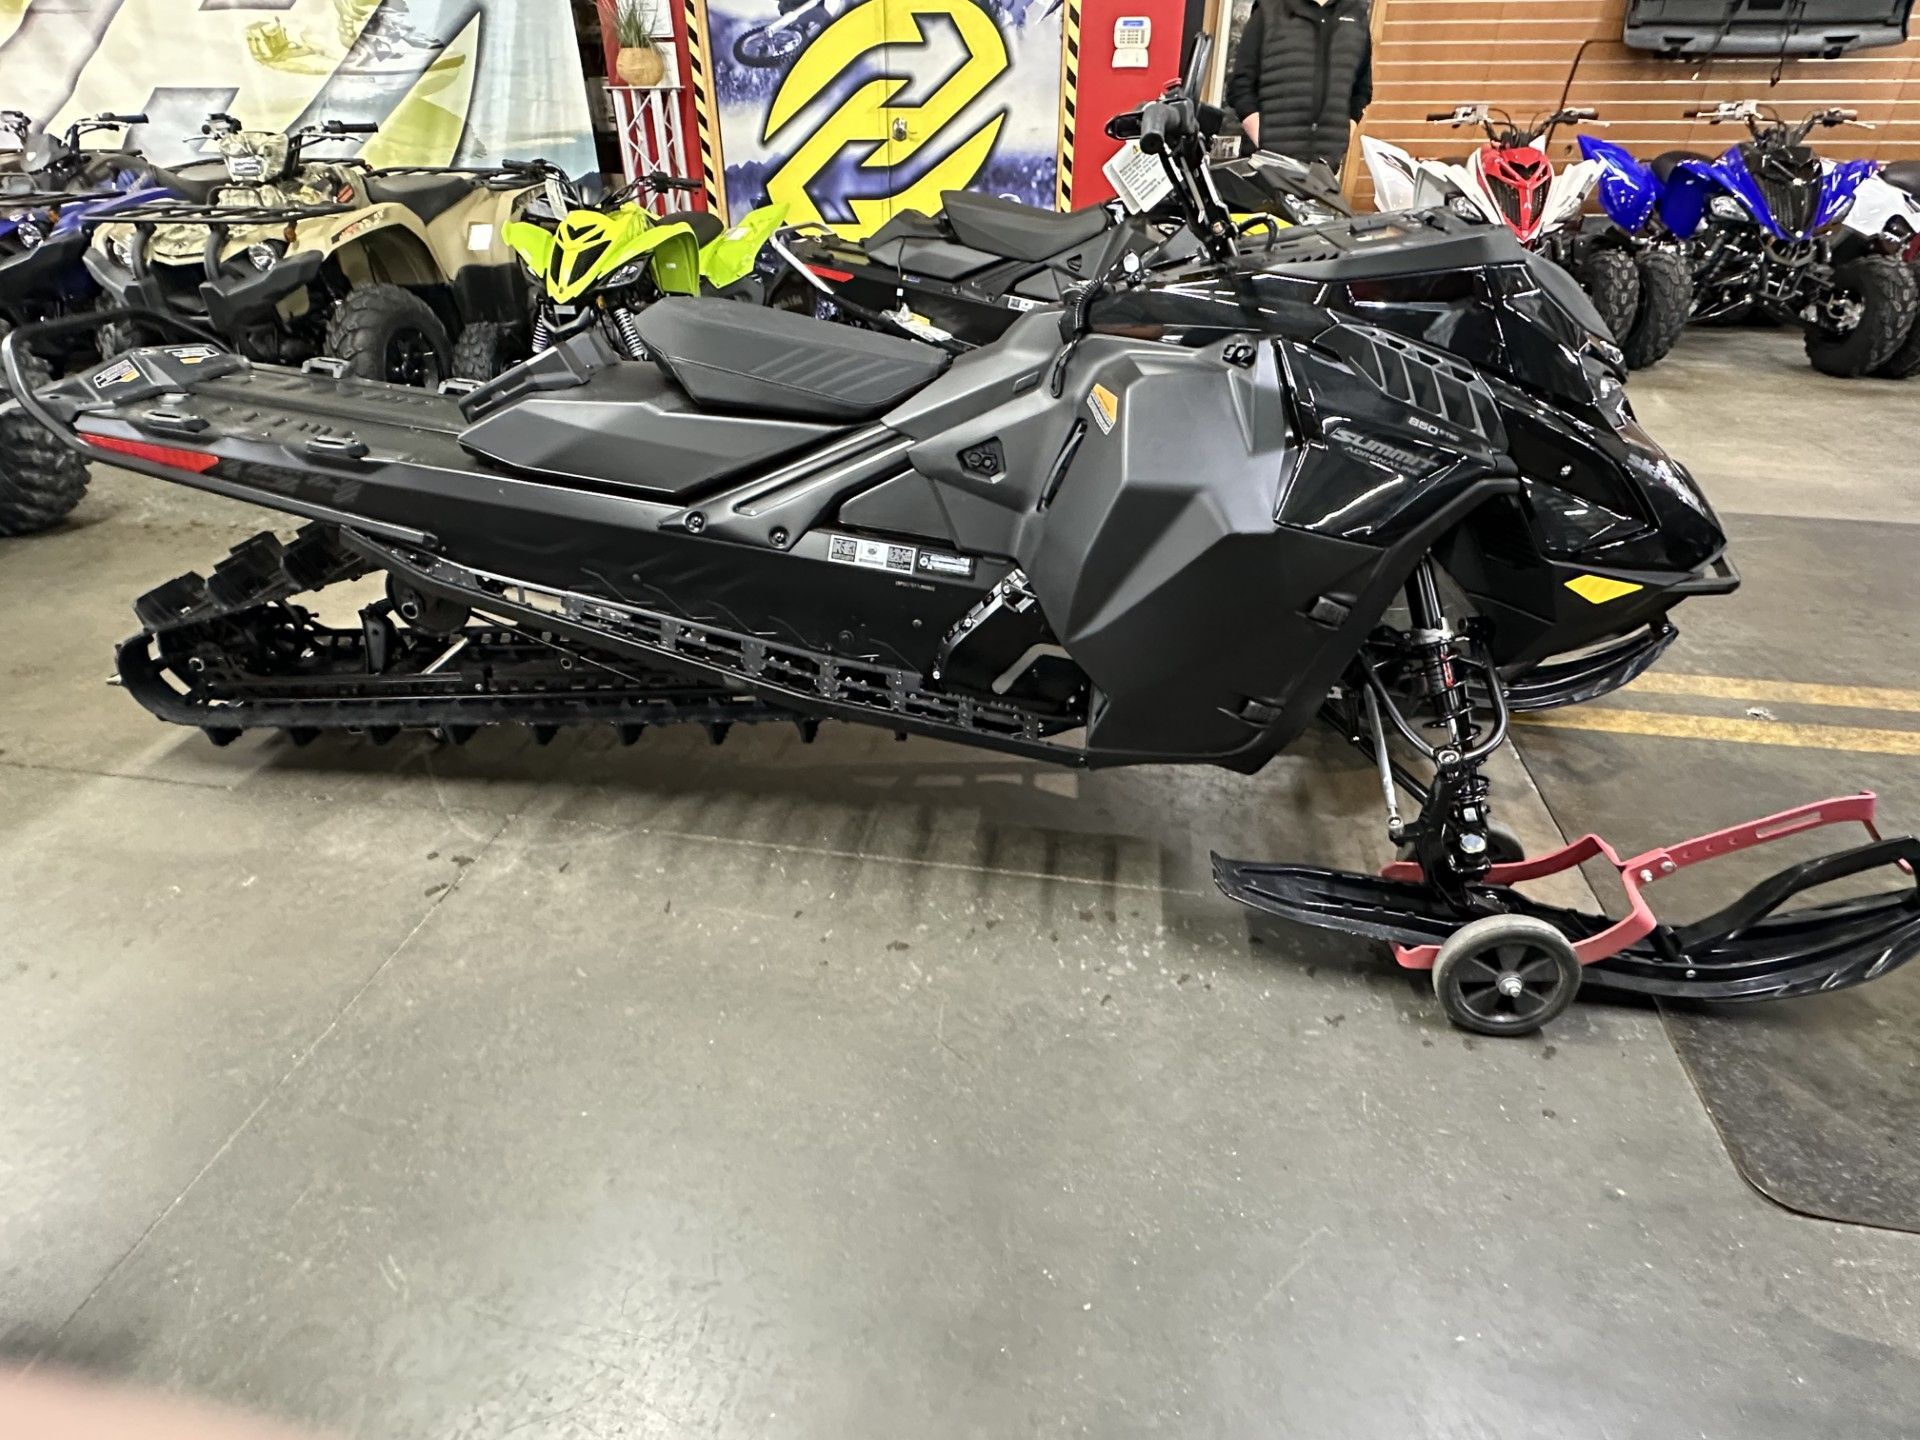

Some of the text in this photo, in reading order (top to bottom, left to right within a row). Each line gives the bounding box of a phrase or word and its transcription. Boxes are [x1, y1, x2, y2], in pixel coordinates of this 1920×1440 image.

[1408, 416, 1438, 435] 850
[1330, 427, 1440, 469] SUMMIT
[1344, 446, 1422, 476] ADRENALINE
